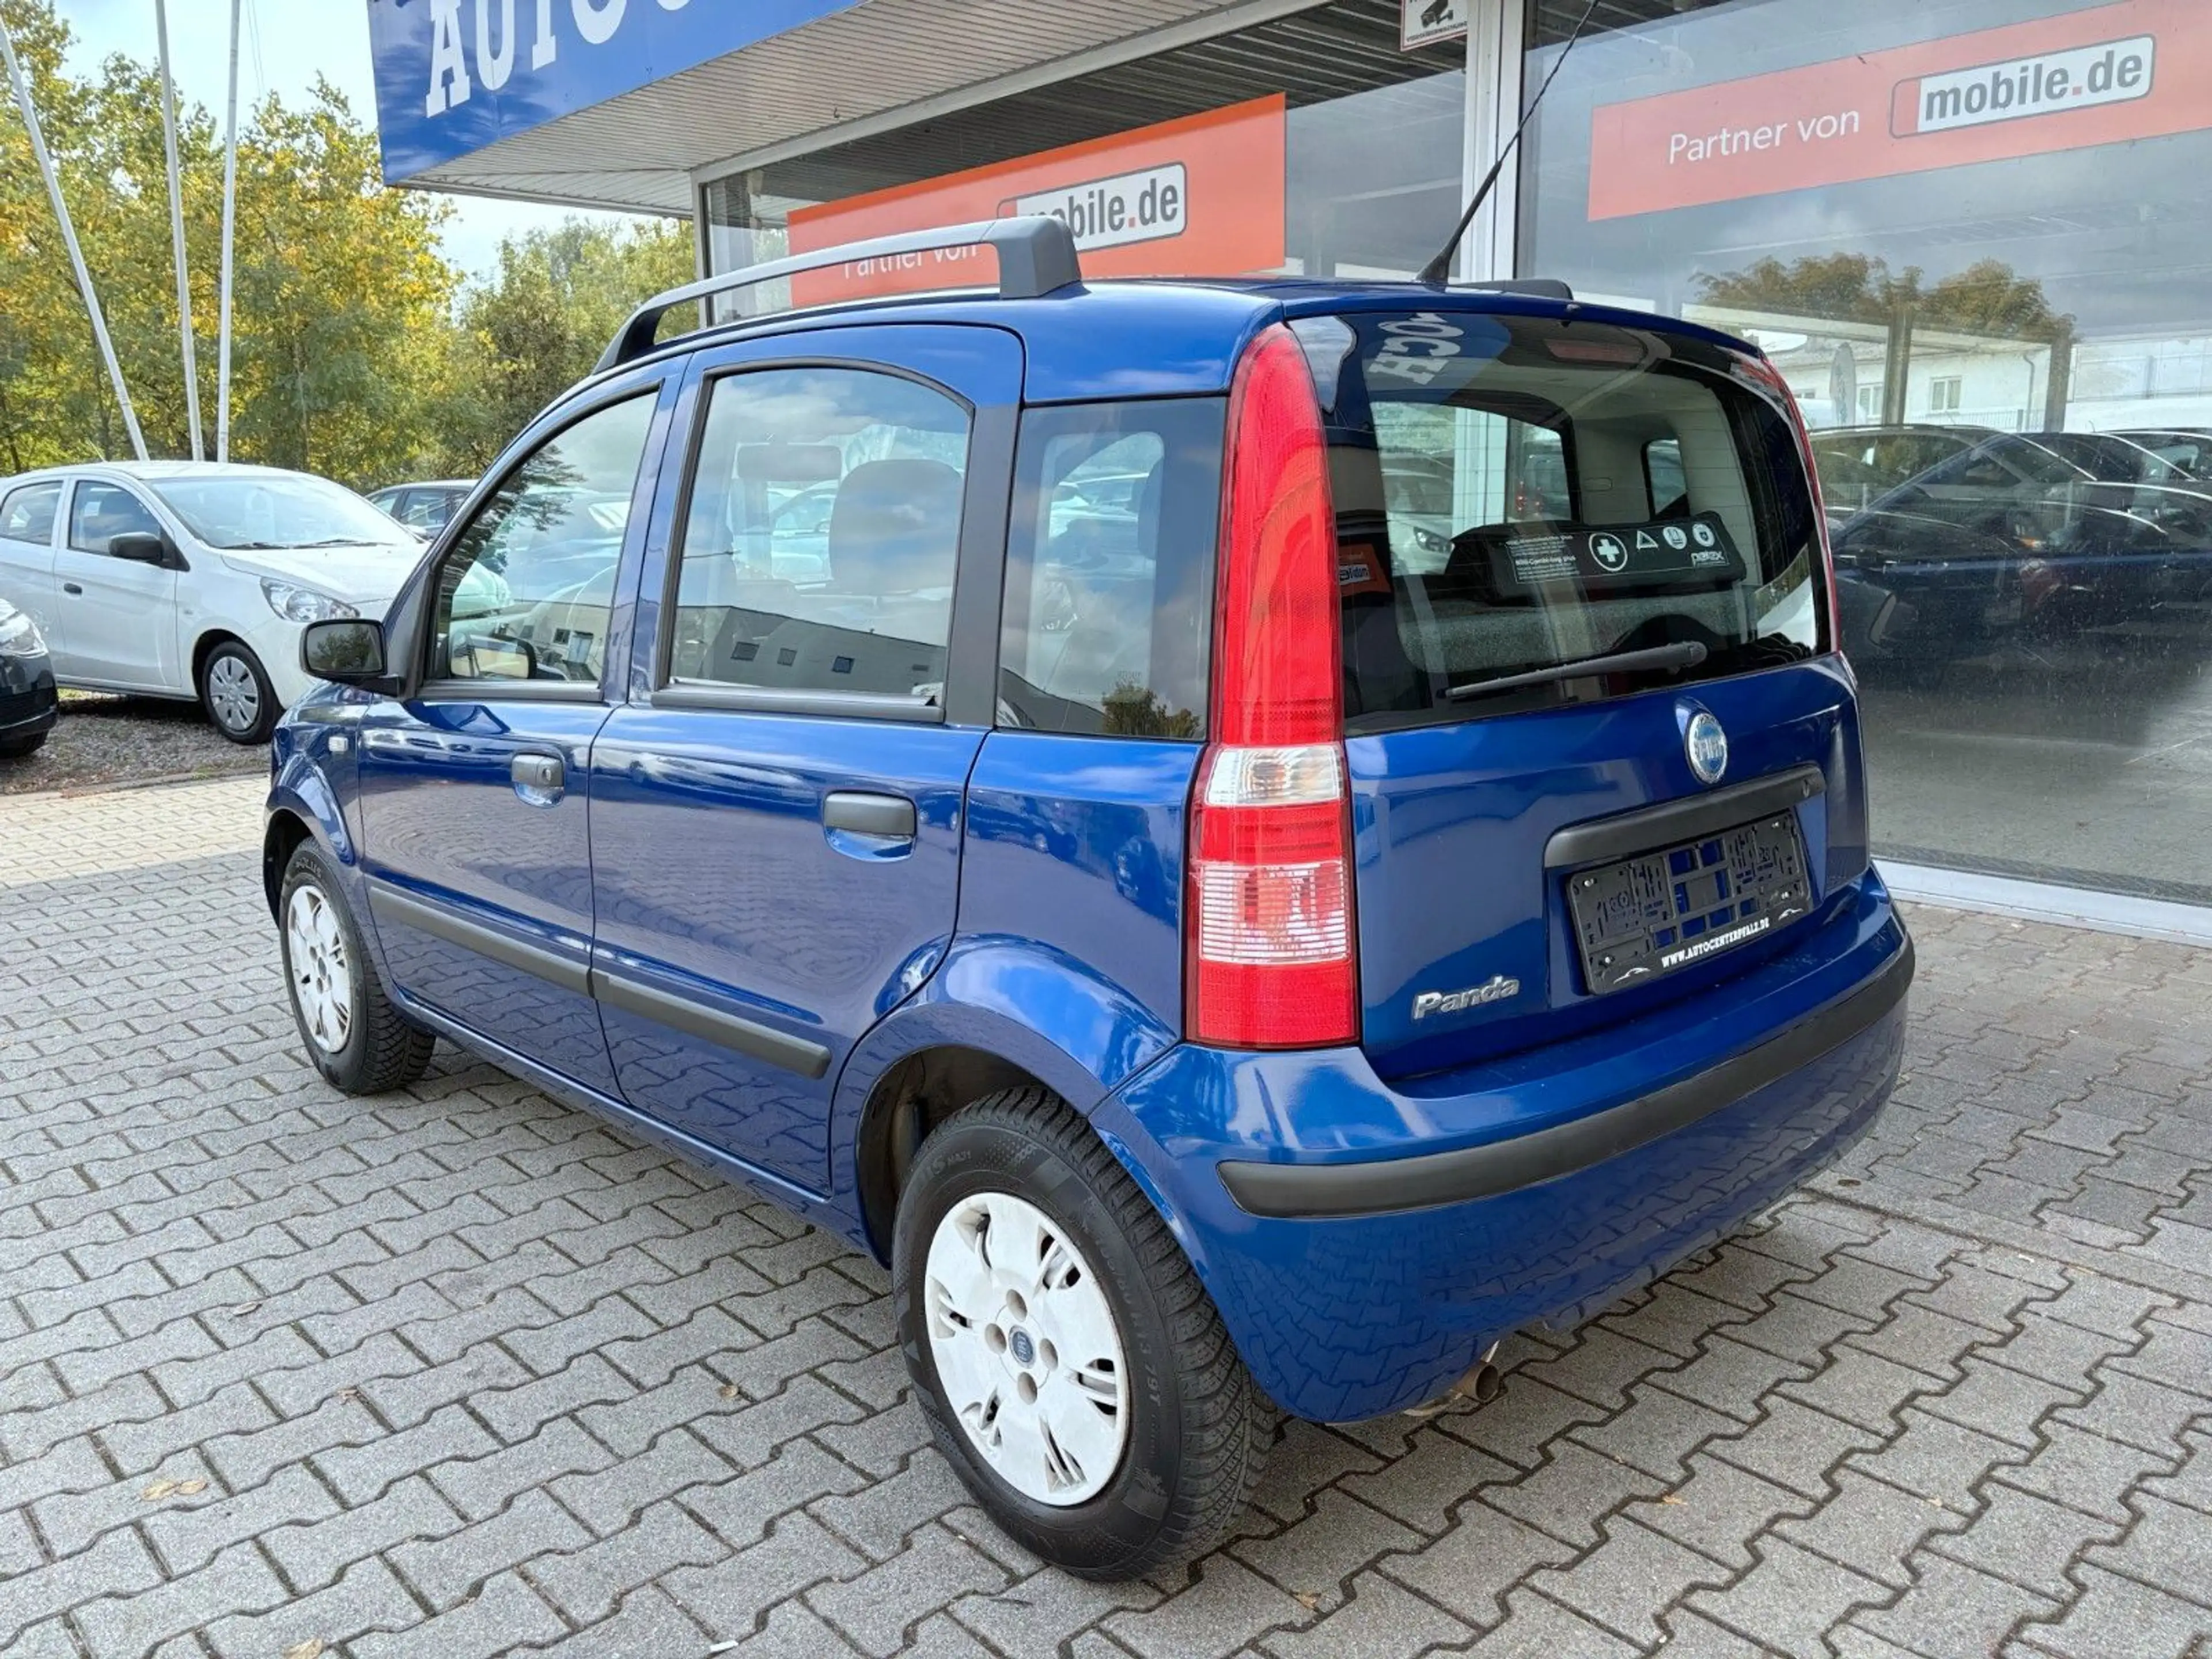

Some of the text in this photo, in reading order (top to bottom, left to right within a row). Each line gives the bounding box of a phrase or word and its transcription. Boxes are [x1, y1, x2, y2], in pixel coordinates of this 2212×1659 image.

[1669, 50, 2143, 164] Partner von mobile.de
[934, 244, 979, 263] von
[1029, 178, 1179, 238] bile.de
[1413, 975, 1520, 1020] Panda
